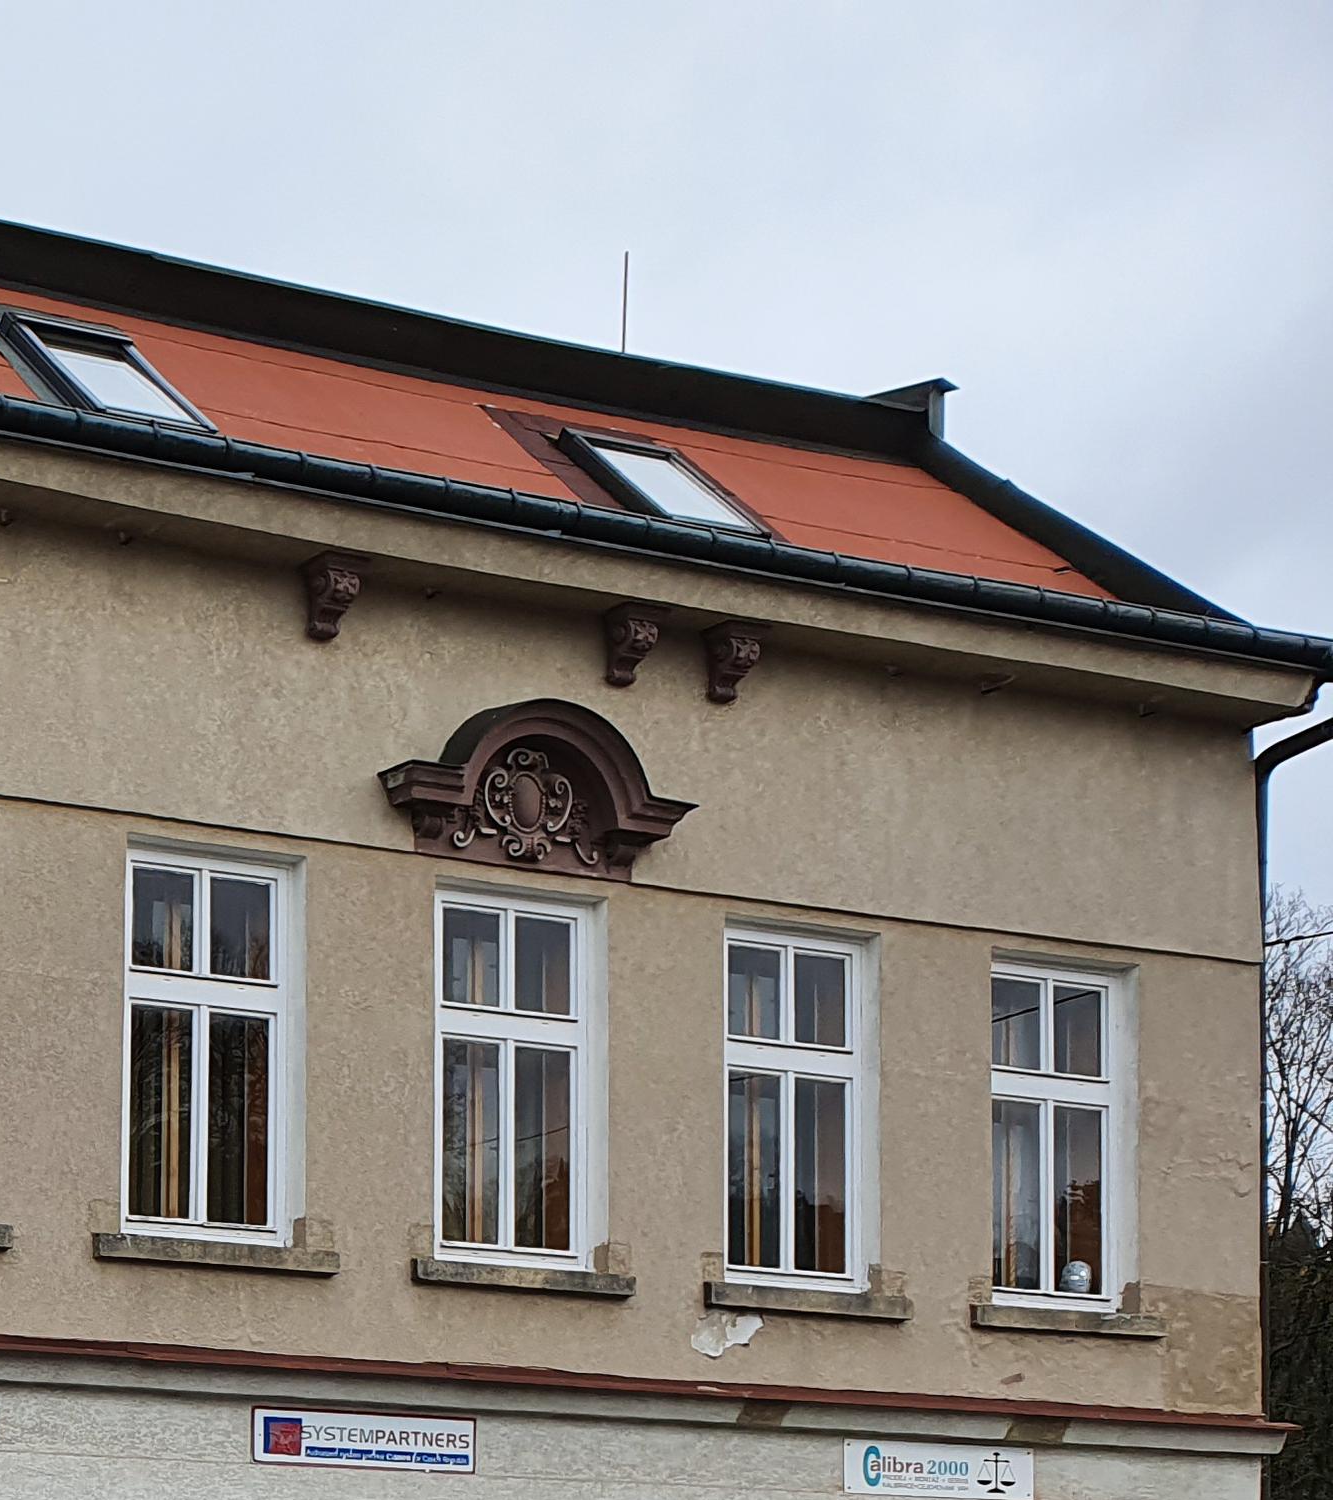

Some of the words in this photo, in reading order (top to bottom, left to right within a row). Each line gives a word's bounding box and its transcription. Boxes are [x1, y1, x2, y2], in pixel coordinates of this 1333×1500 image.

[301, 1424, 470, 1450] SYSTEMPARTNERS
[863, 1445, 924, 1487] Calibra
[926, 1459, 969, 1477] 2000
